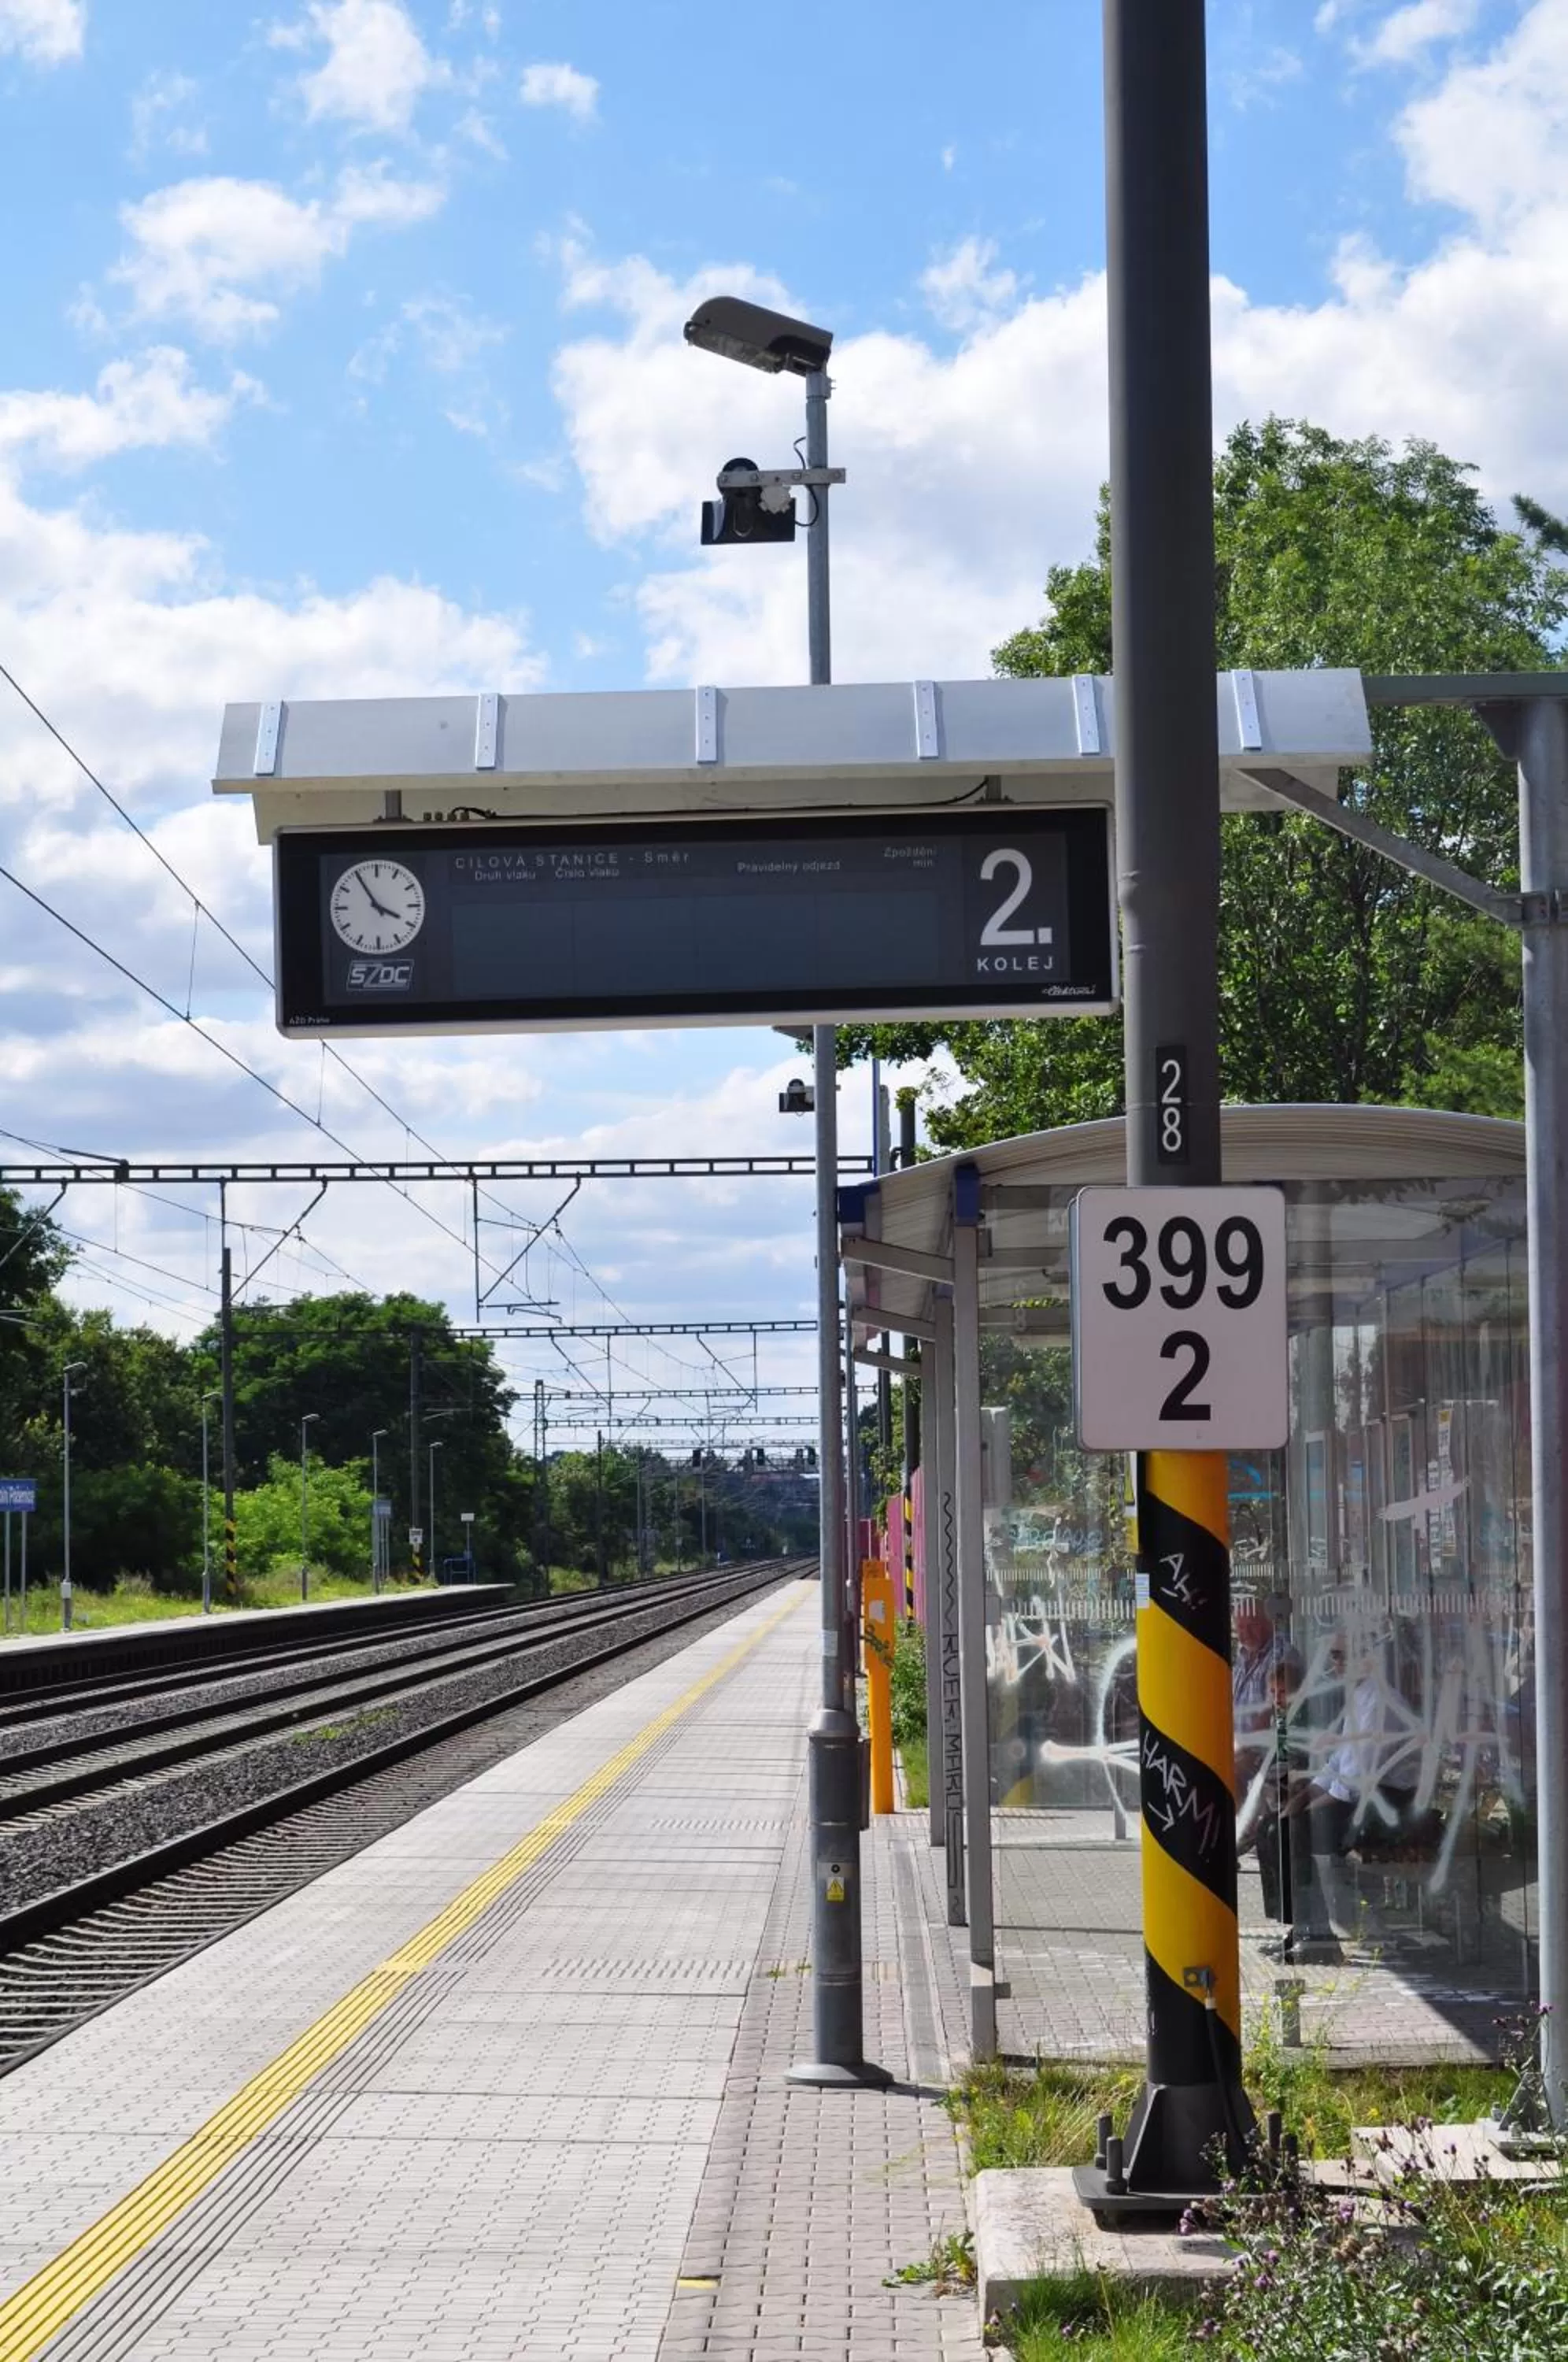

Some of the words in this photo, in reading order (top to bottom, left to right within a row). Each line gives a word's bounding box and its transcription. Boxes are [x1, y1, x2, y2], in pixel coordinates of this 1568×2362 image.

[536, 853, 617, 868] STANICE
[976, 956, 1054, 972] KOLEJ
[1102, 1216, 1264, 1310] 399
[1159, 1331, 1211, 1421] 2
